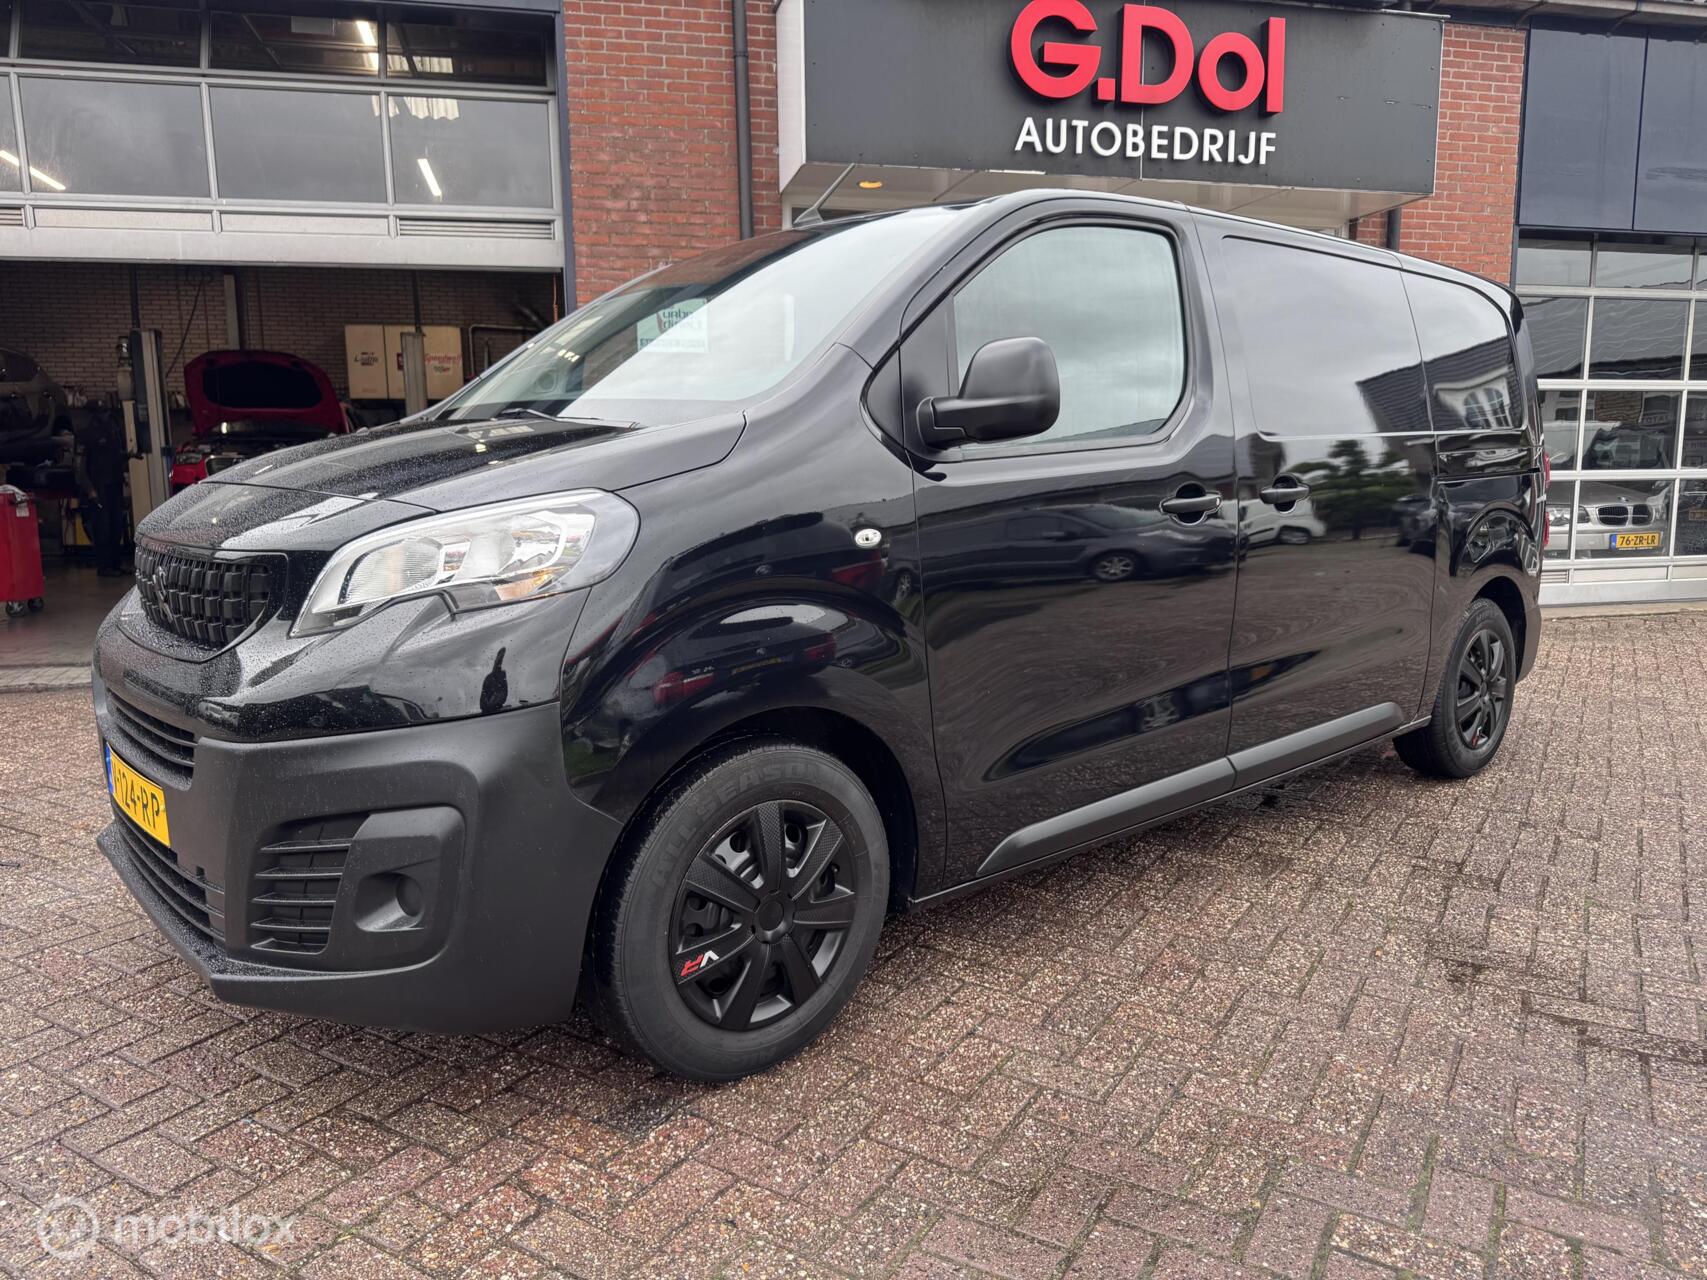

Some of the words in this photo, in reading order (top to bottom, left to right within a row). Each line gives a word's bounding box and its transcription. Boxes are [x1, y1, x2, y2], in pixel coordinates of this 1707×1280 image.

[1010, 0, 1286, 113] G.Dol
[1014, 117, 1276, 165] AUTOBEDRIJF
[1619, 535, 1656, 546] 76-ZR-LR
